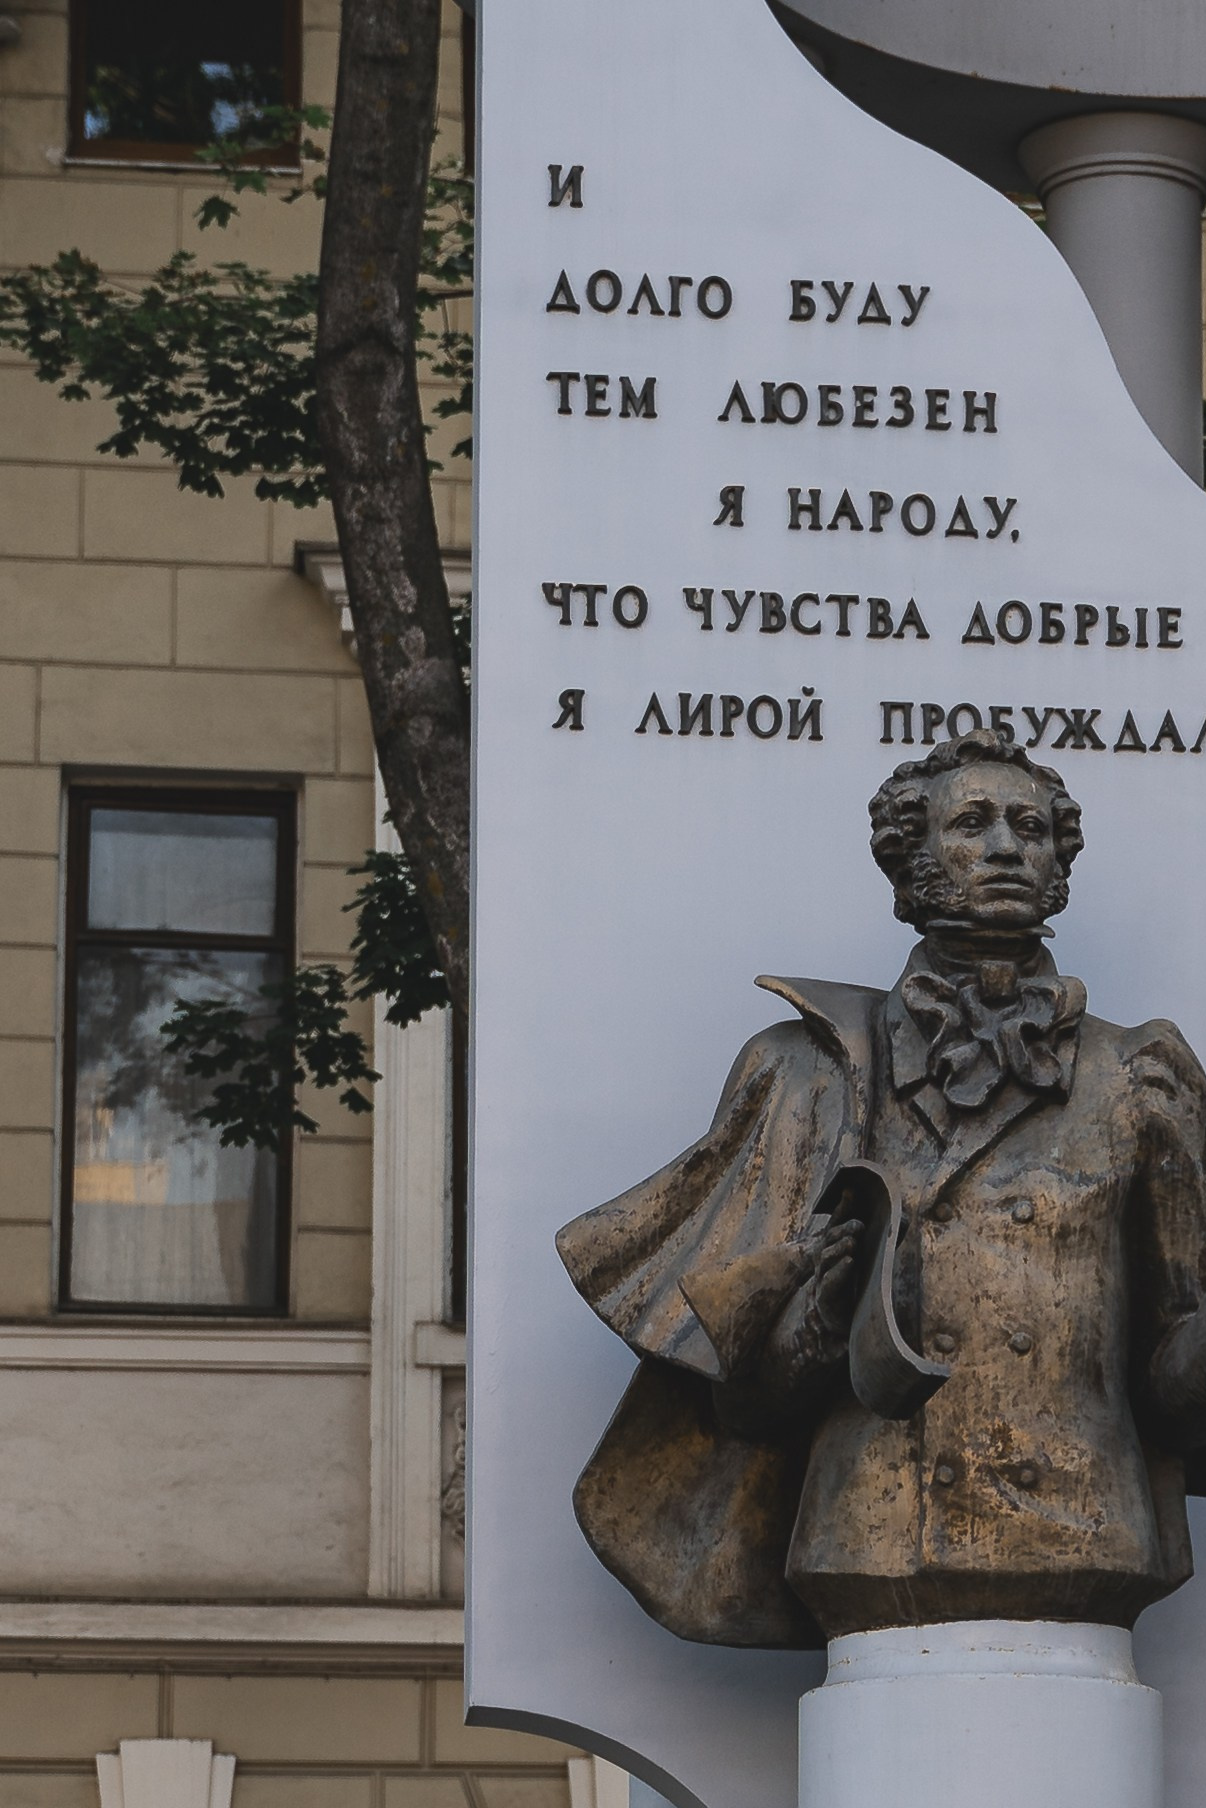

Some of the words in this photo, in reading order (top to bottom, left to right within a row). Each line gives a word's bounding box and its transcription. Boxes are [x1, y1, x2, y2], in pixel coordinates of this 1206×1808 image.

[547, 163, 585, 209] И
[545, 269, 733, 320] ДОЛГО
[788, 279, 931, 328] БУДУ
[545, 371, 658, 420] ТЕМ
[717, 379, 998, 434] ЛЮБЕЗЕН
[712, 485, 746, 528] Я
[787, 487, 1020, 544] НАРОДУ,
[541, 582, 649, 630] ЧТО
[682, 587, 931, 640] ЧУВСТВА
[961, 600, 1184, 649] ДОБРЫЕ
[551, 688, 586, 732] Я
[634, 685, 824, 742] ЛИРОЙ
